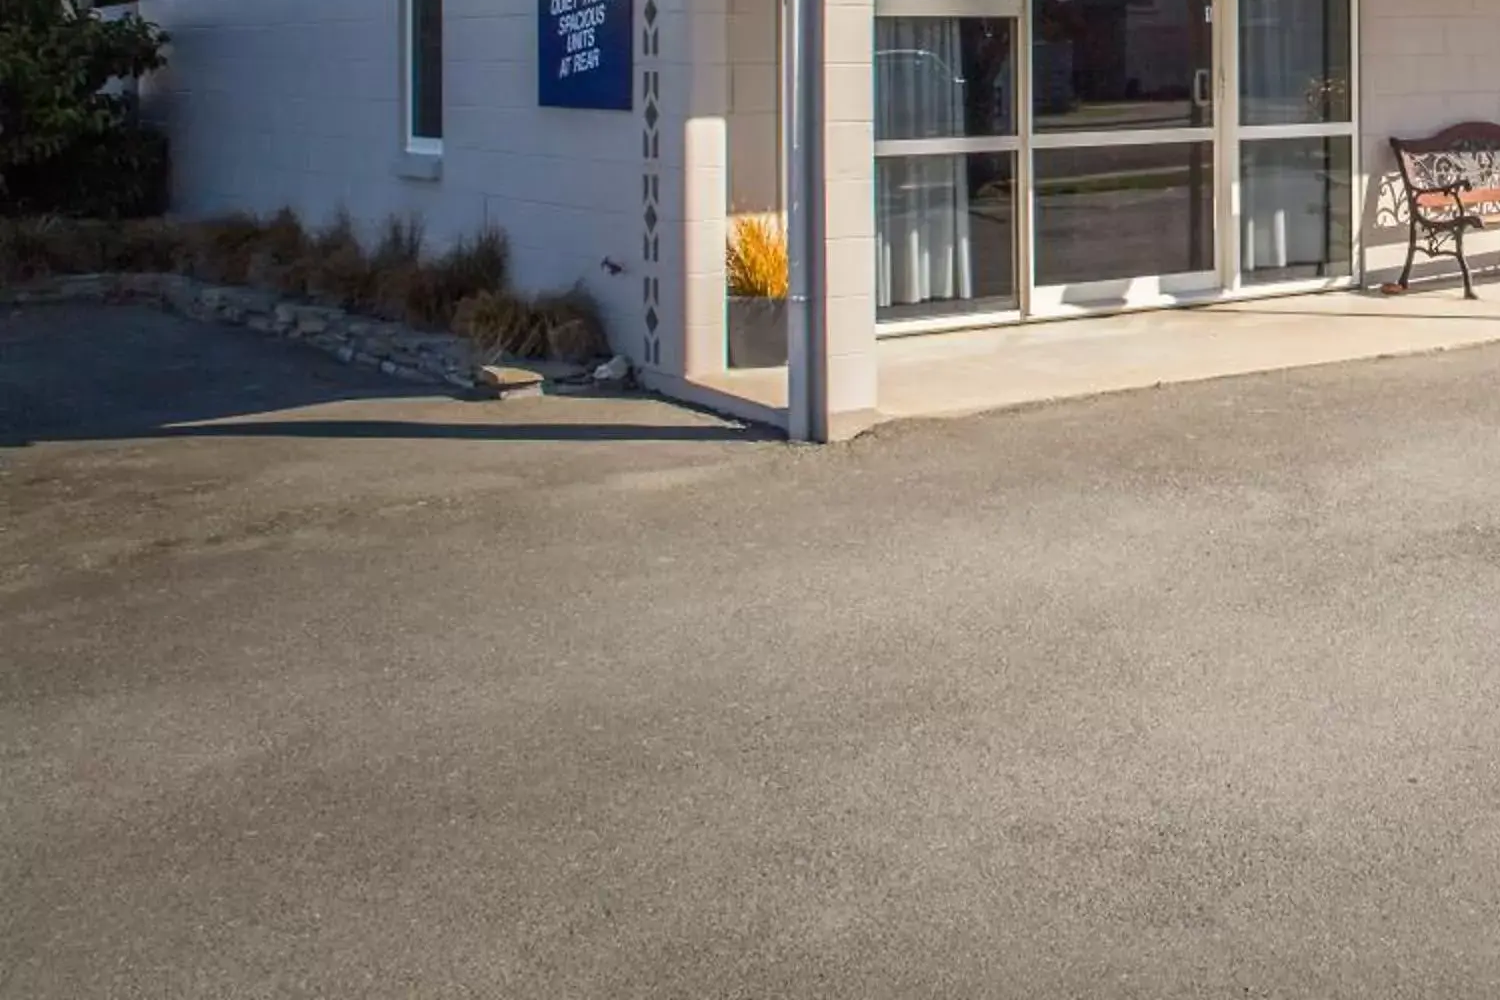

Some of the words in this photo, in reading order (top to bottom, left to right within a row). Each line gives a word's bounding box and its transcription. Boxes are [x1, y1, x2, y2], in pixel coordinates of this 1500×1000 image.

[557, 3, 607, 36] SPACIOUS
[566, 27, 596, 54] UNITS
[559, 56, 573, 80] AT
[573, 48, 601, 74] REAR
